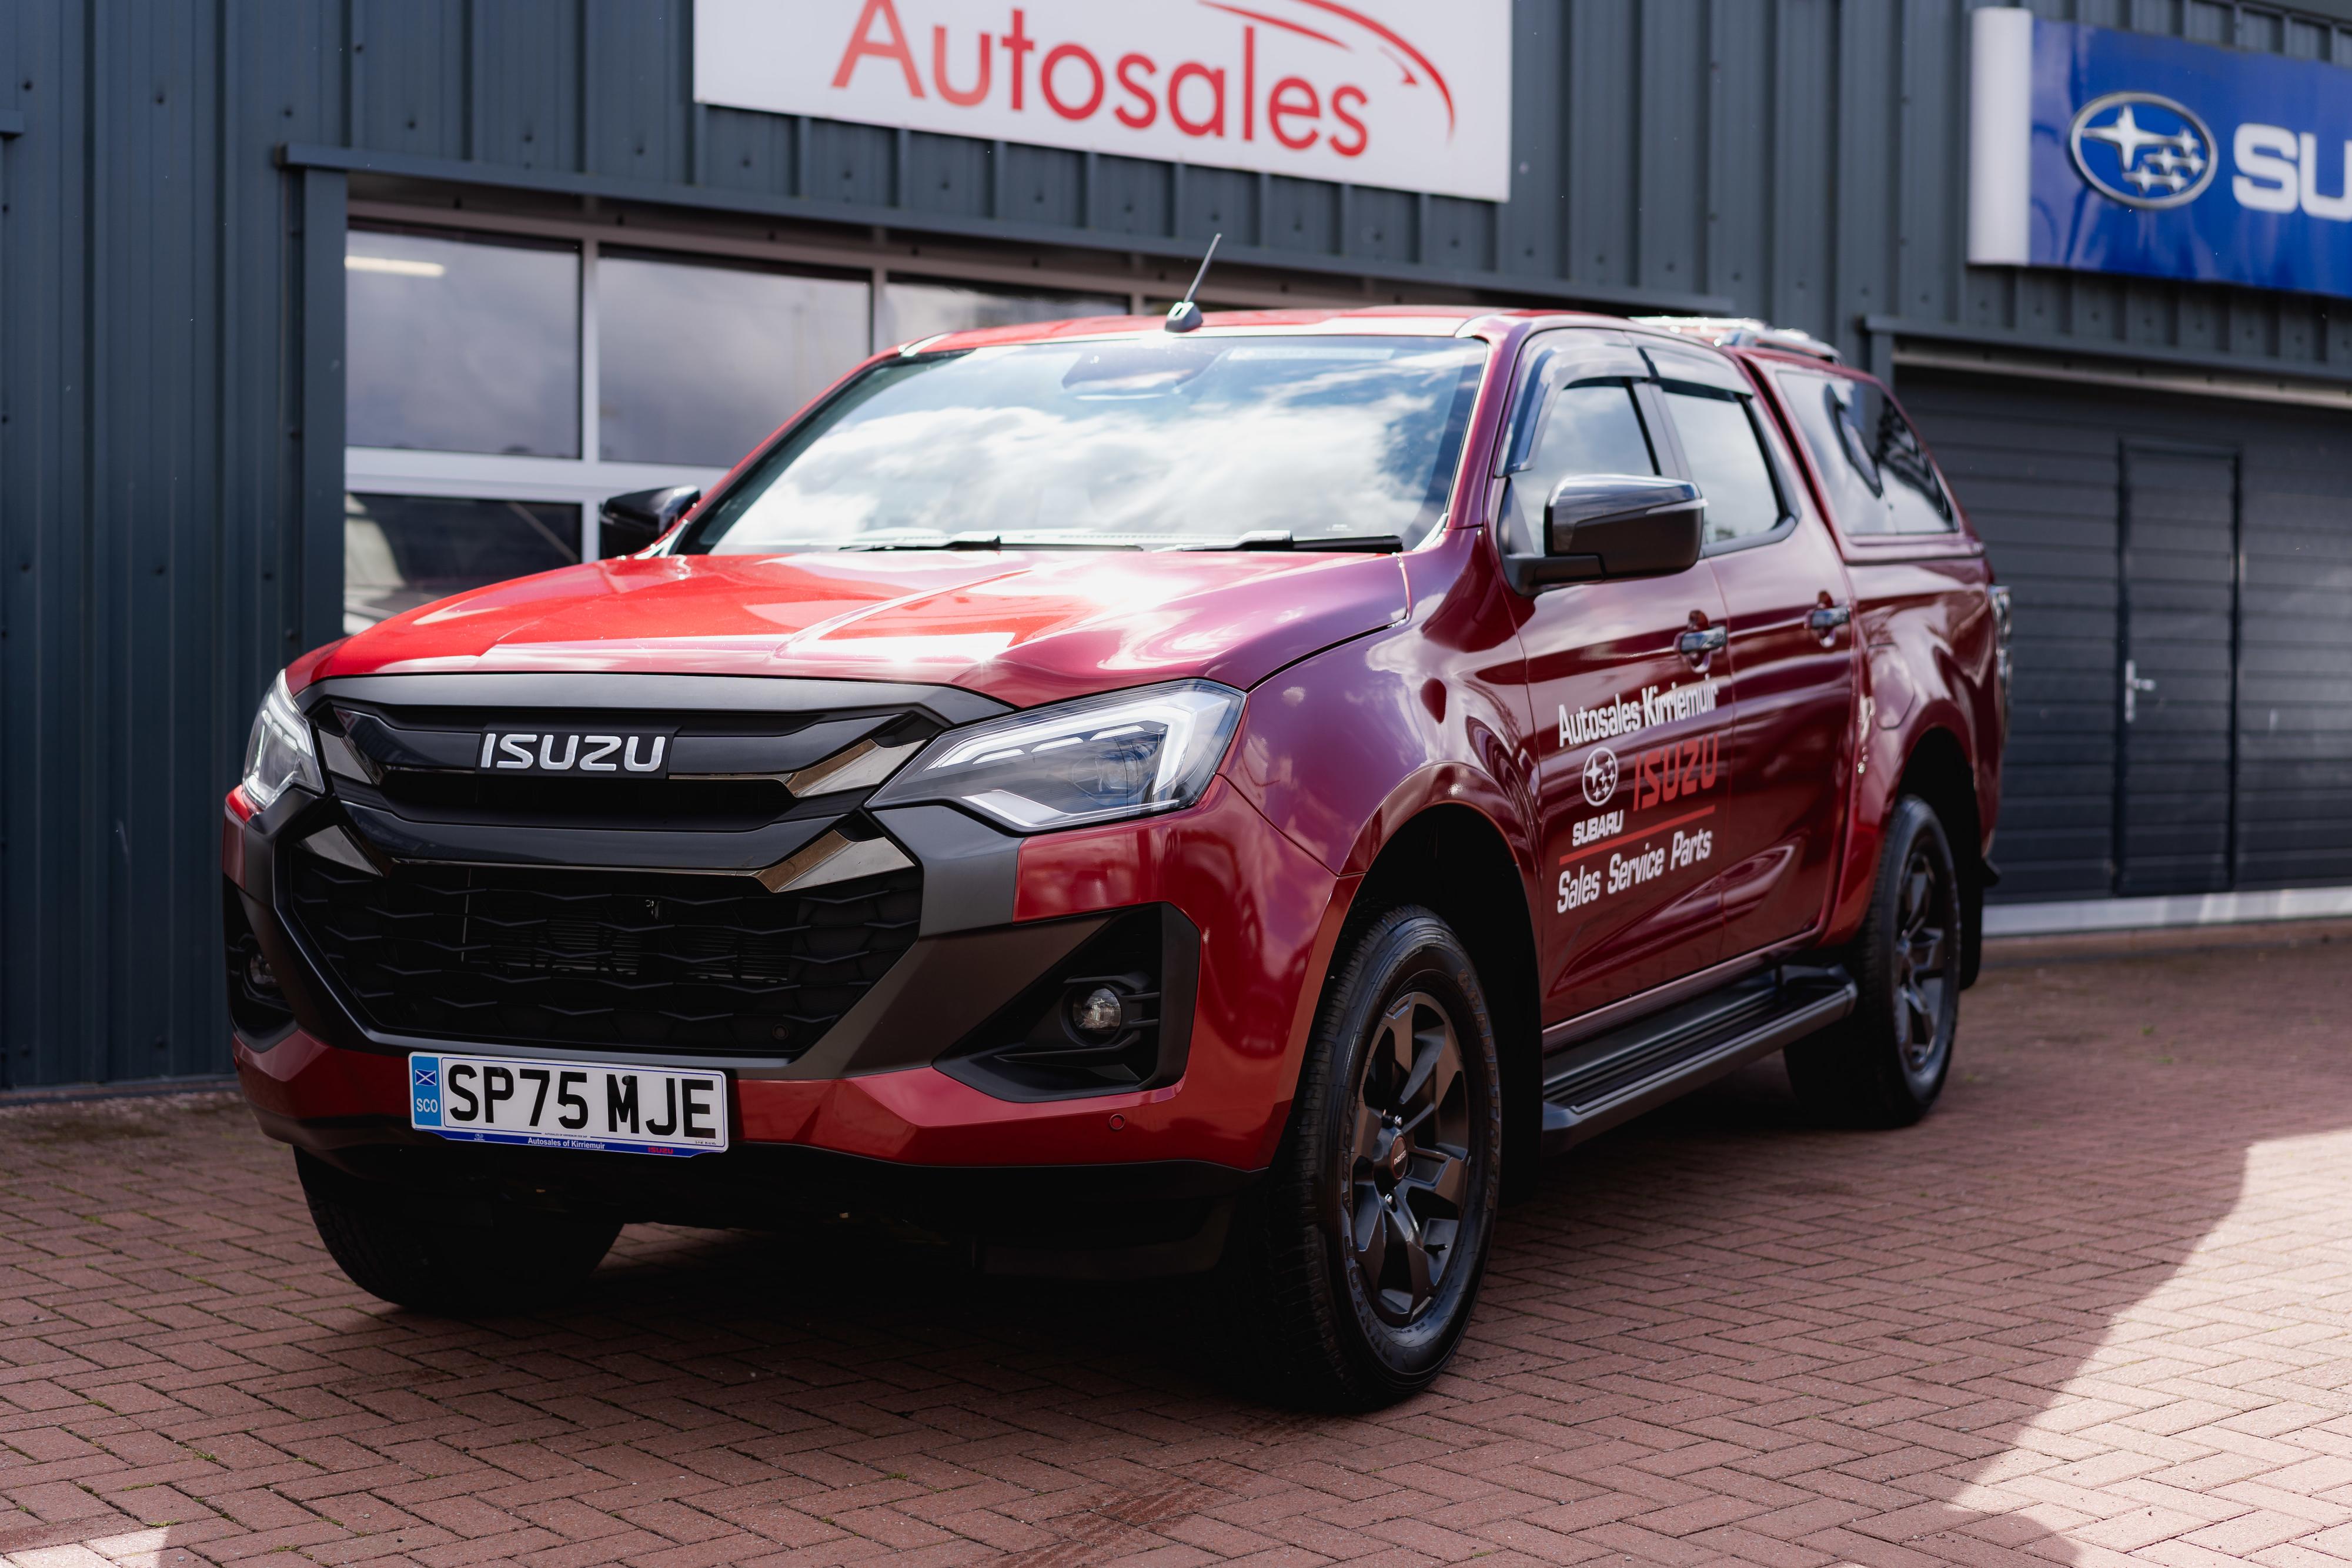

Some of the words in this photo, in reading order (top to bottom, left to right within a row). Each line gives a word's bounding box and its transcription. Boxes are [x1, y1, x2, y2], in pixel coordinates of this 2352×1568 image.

[831, 0, 1367, 157] Autosales
[1559, 693, 1641, 747] Autosales
[1641, 673, 1719, 728] Kirriemuir
[481, 733, 666, 772] ISUZU
[1633, 733, 1718, 812] ISUZU
[1572, 809, 1625, 847] SUBARU
[1557, 865, 1601, 914] Sales
[1607, 842, 1665, 894] Service
[1670, 828, 1713, 871] Parts
[416, 1098, 438, 1113] SCO
[447, 1064, 589, 1129] SP75
[606, 1074, 716, 1139] MJE
[527, 1137, 562, 1146] Autosales
[563, 1139, 570, 1147] of
[572, 1140, 606, 1150] Kirriemuir
[647, 1146, 674, 1155] ISUZU
